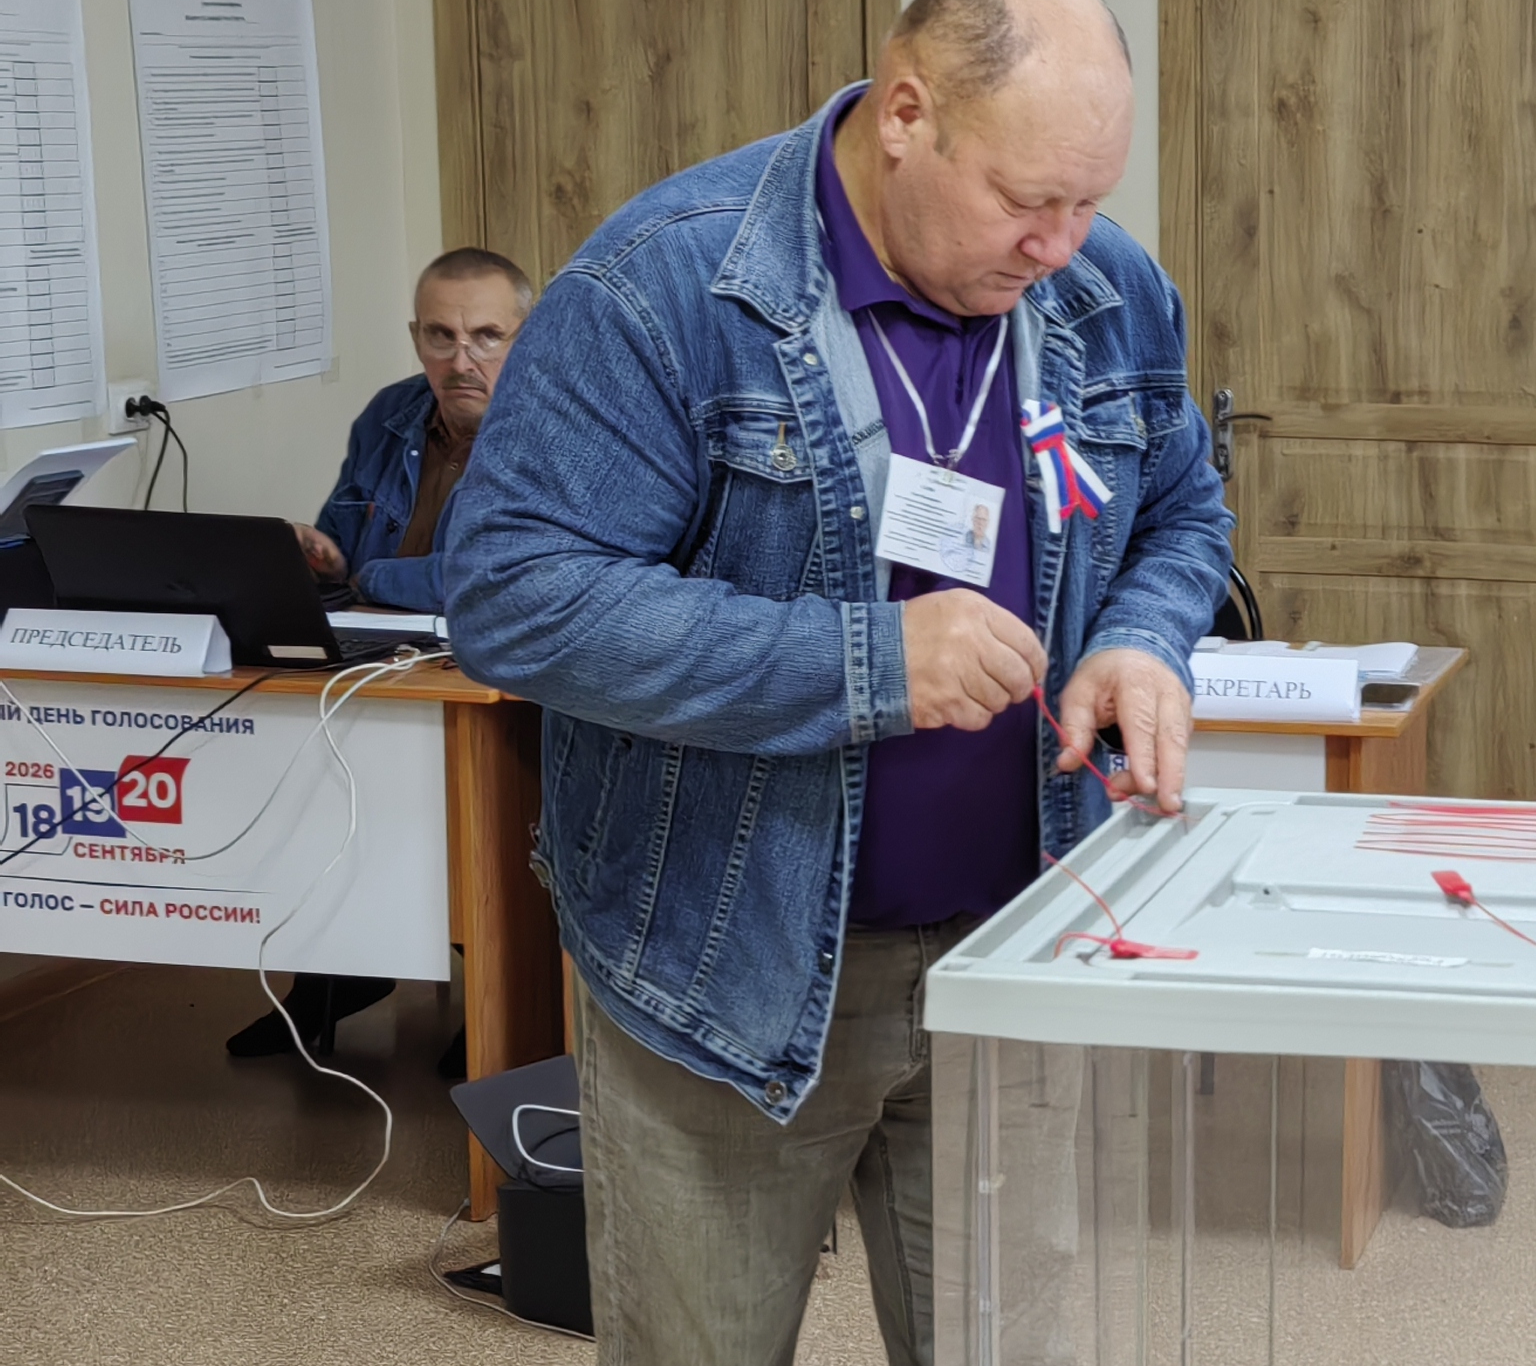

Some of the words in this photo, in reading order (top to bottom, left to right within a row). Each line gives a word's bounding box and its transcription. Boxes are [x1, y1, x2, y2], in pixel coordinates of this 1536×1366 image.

[10, 627, 182, 655] ПРЕДСЕДАТЕЛЬ
[1194, 677, 1312, 700] ЕКРЕТАРЬ
[27, 706, 85, 726] ДЕНЬ
[90, 710, 255, 735] ГОЛОСОВАНИЯ
[5, 761, 55, 779] 2026
[13, 802, 58, 840] 18
[121, 770, 177, 809] 20
[73, 842, 186, 865] СЕНТЯБРЯ
[3, 891, 75, 911] ГОЛОС
[100, 898, 159, 918] СИЛА
[165, 903, 261, 924] РОССИИ!
